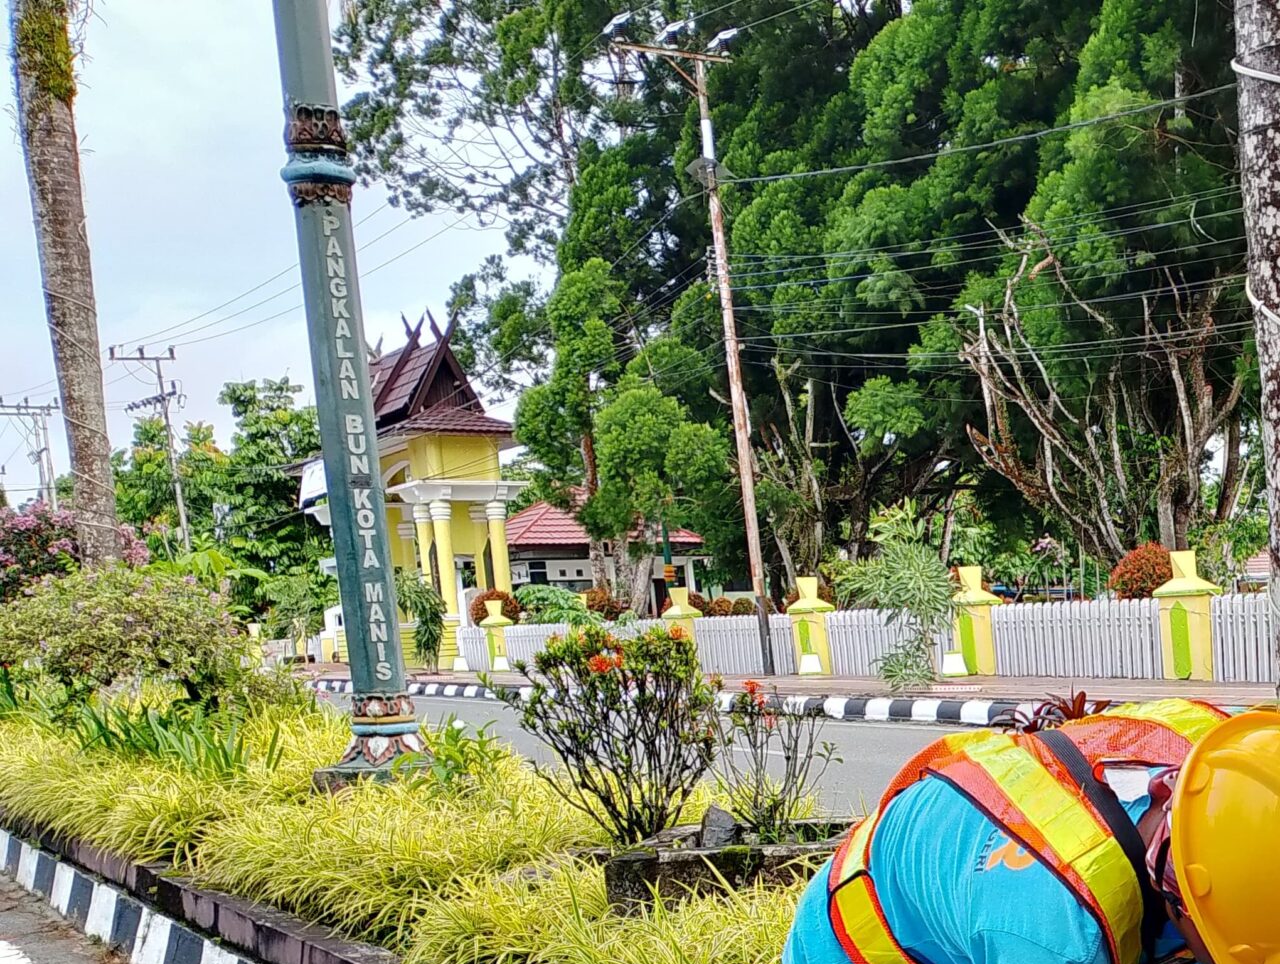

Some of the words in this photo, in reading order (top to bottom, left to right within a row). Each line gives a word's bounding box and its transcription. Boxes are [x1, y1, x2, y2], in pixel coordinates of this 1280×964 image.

[322, 215, 359, 400] PANGKALAN
[345, 414, 370, 475] BUN
[353, 488, 380, 569] KOTA
[365, 581, 392, 681] MANIS
